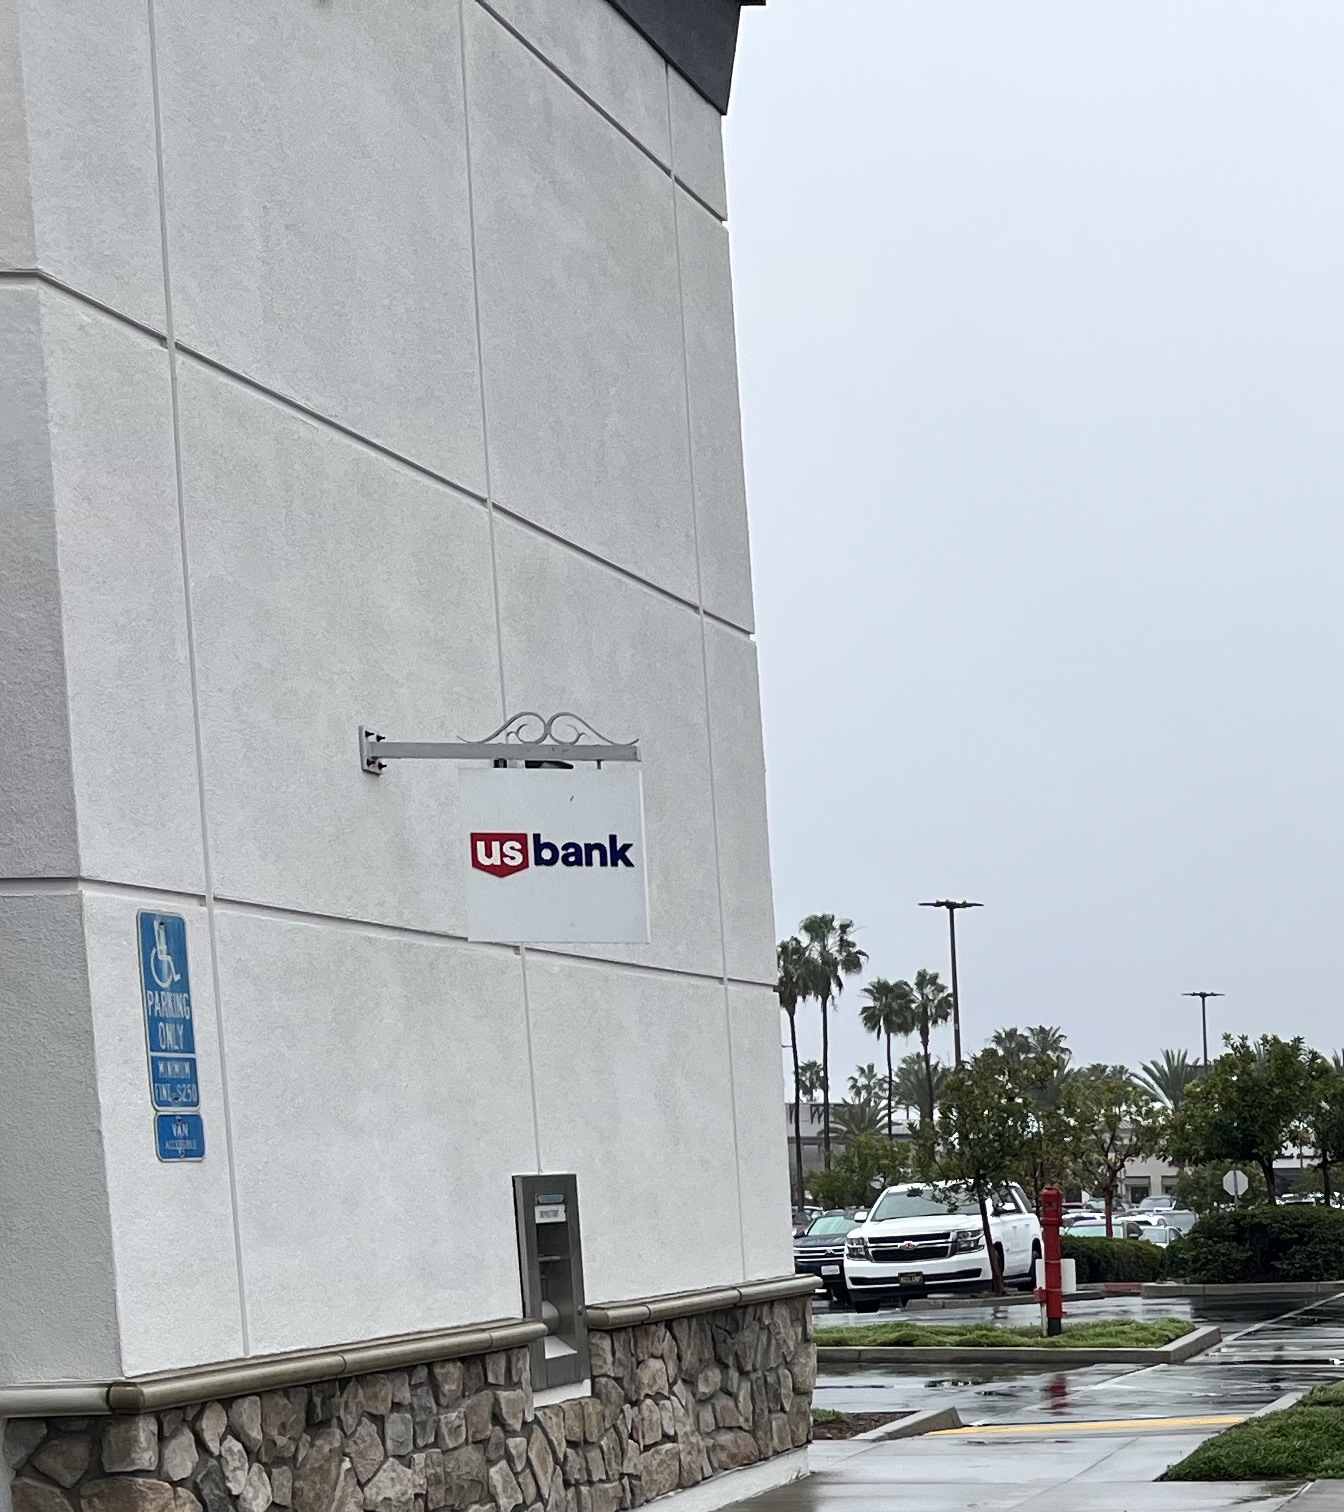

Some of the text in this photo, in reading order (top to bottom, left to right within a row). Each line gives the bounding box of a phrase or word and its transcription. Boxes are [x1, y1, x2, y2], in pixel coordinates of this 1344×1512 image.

[476, 832, 635, 868] us bank
[146, 990, 191, 1020] PARKING
[158, 1021, 184, 1050] ONLY
[171, 1123, 189, 1138] VAN
